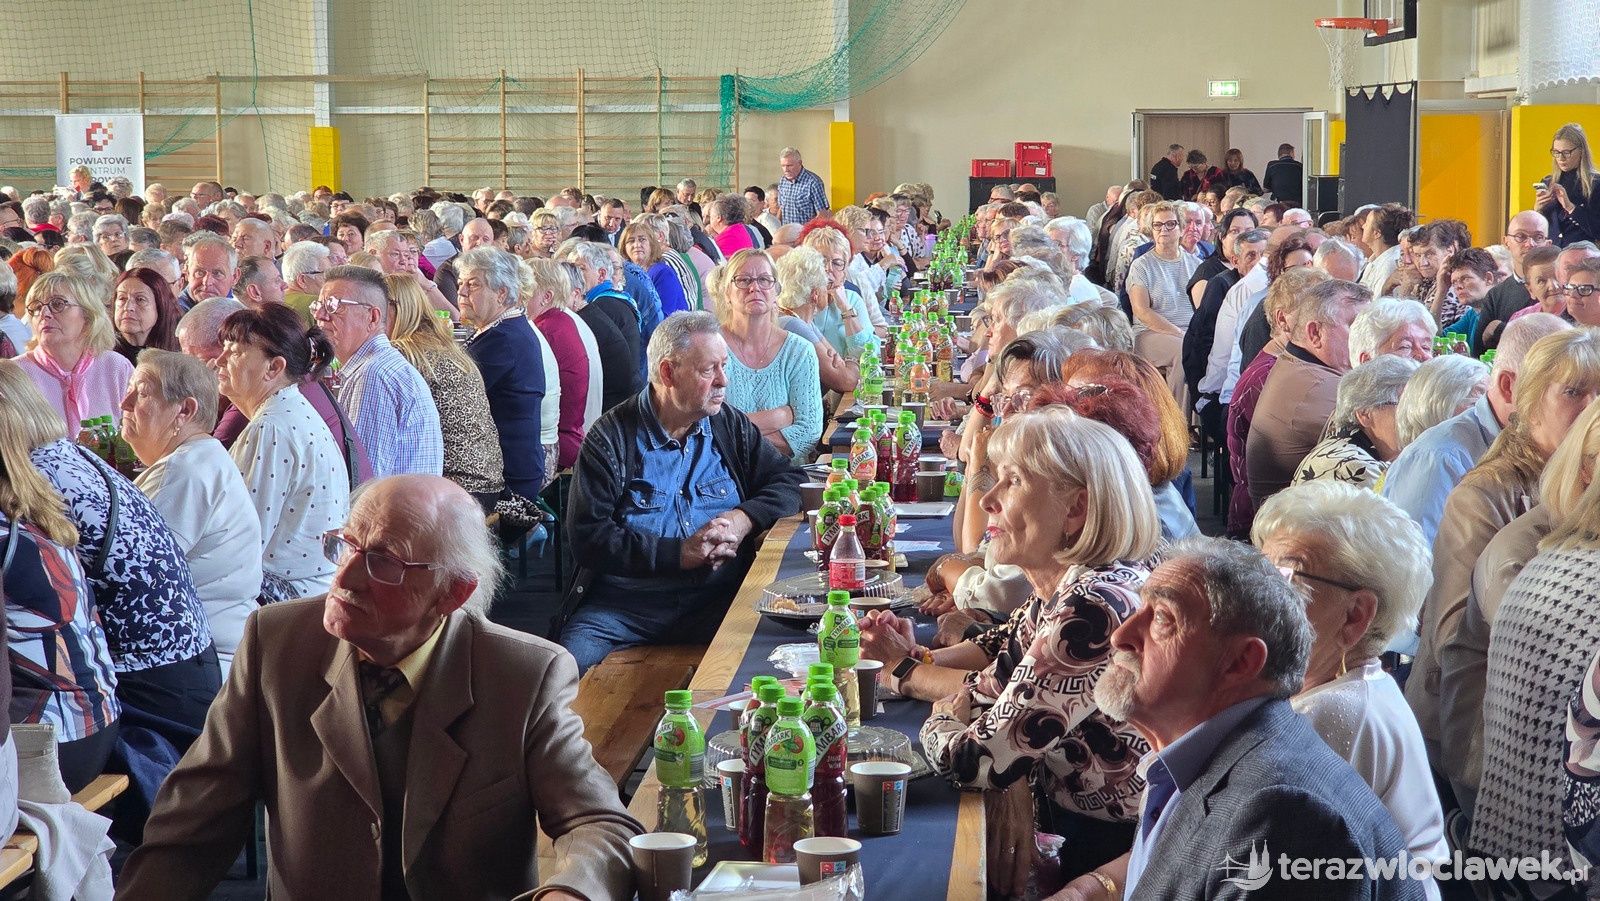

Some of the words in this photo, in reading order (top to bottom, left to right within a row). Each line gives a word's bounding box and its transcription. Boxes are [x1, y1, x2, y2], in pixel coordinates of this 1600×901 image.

[69, 156, 132, 165] POWIATOWE
[90, 167, 126, 175] NTRUM
[764, 729, 791, 752] MBARK
[816, 721, 847, 757] MBARK
